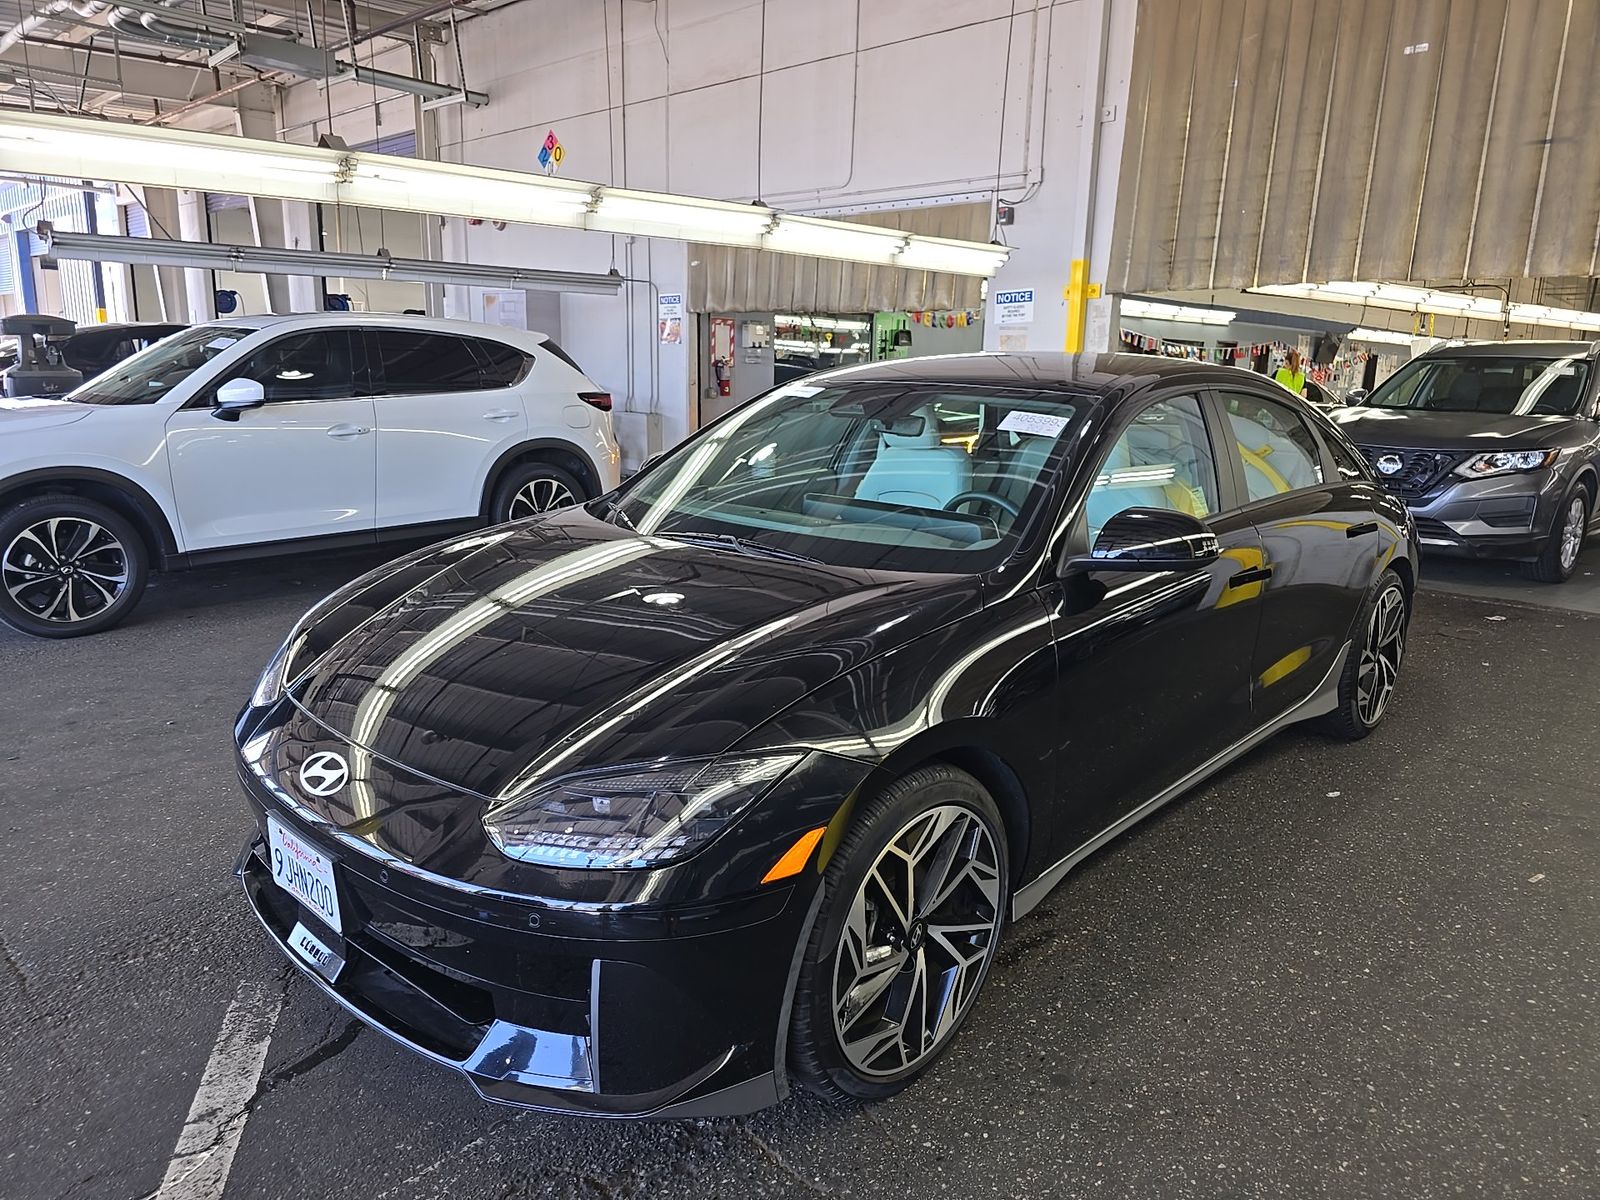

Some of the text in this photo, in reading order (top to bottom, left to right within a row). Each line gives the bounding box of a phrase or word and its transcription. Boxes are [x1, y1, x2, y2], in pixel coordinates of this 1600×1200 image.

[547, 134, 554, 151] 3
[554, 146, 562, 162] 0
[660, 296, 681, 304] NOTICE
[997, 291, 1032, 303] NOTICE
